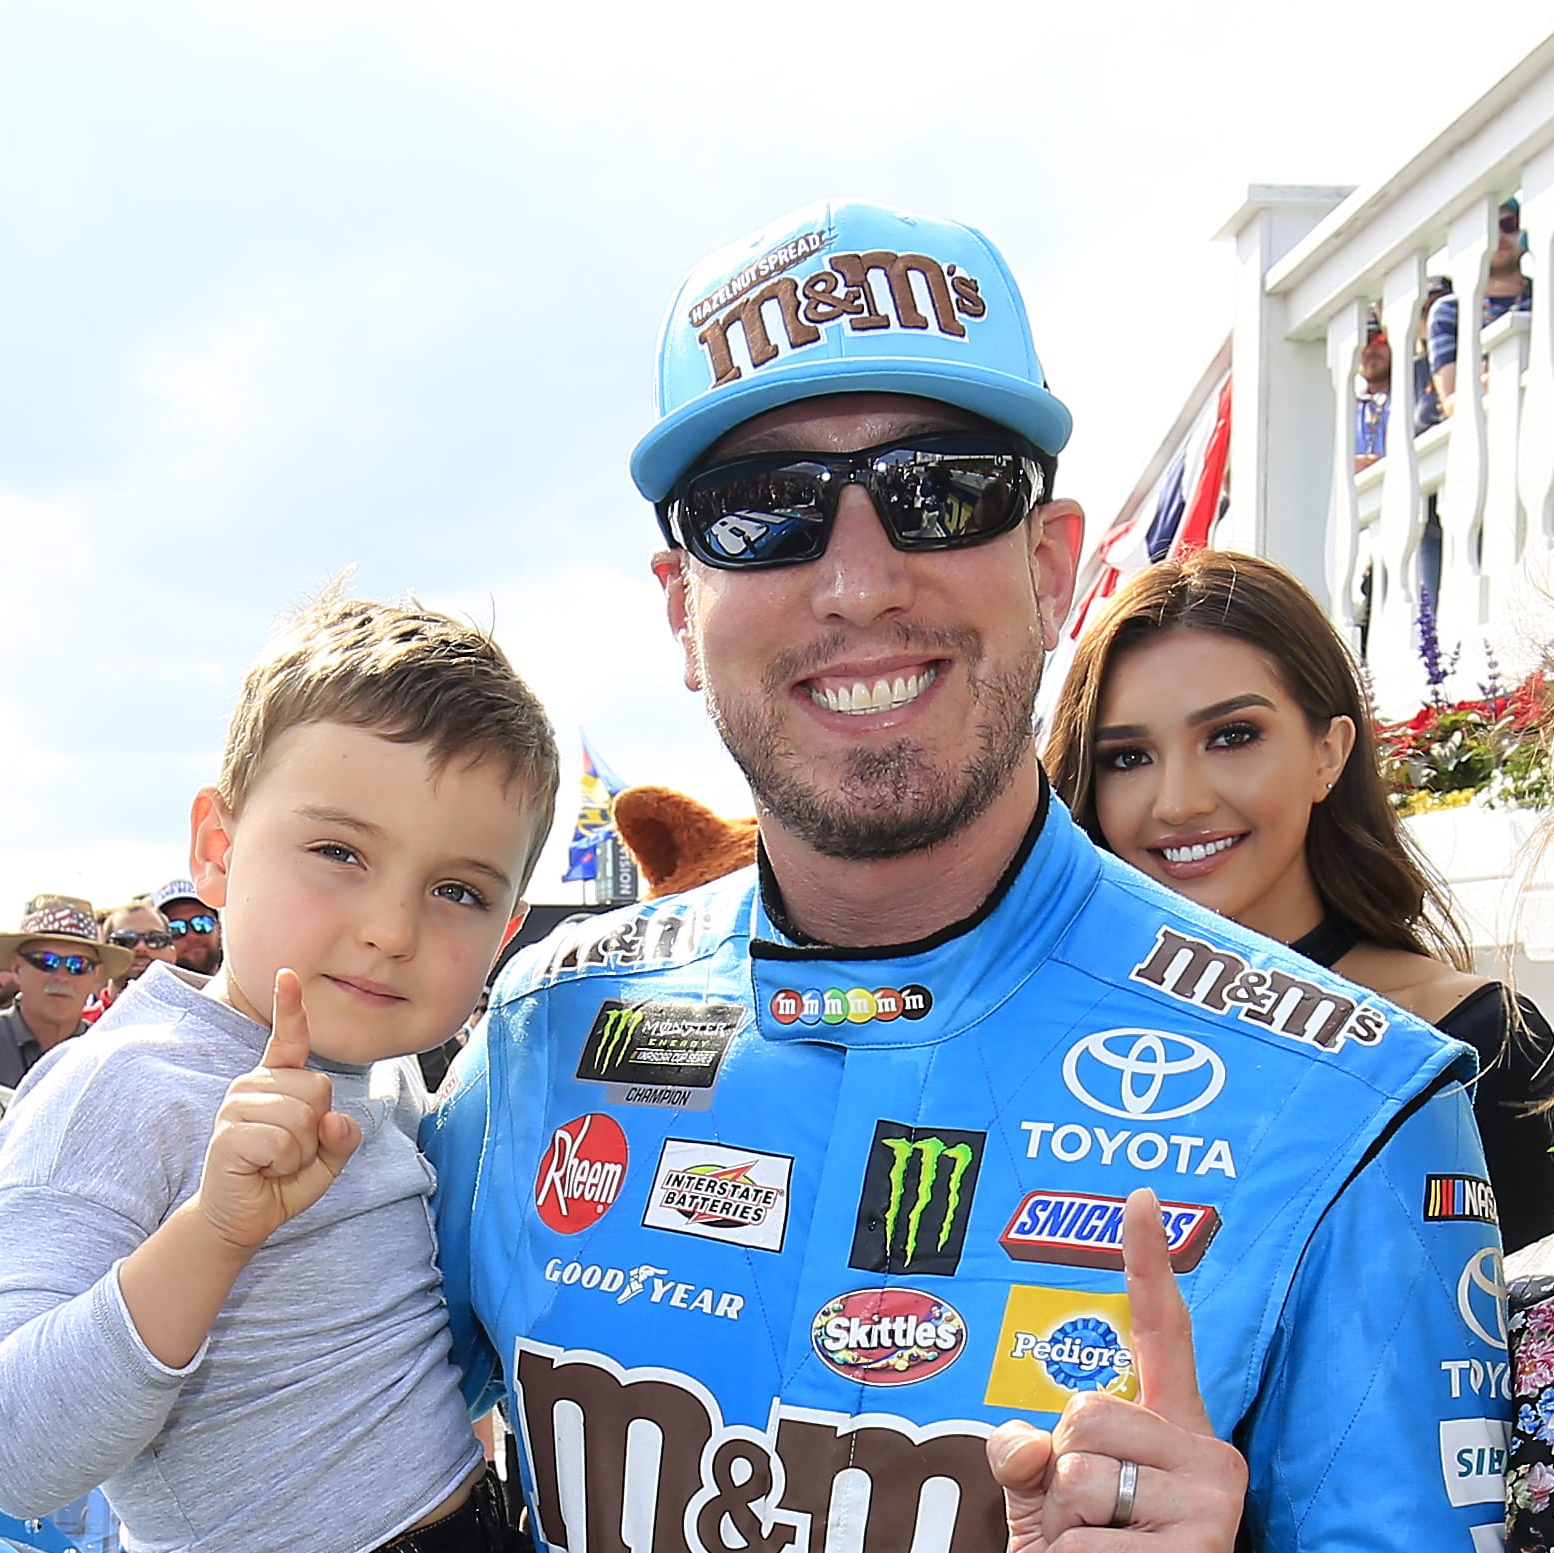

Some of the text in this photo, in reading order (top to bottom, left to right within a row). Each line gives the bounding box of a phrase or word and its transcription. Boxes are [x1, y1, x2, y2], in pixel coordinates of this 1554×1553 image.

[692, 233, 821, 324] HAZELNUT SPREAD
[625, 1087, 691, 1106] CHAMPION
[537, 1114, 623, 1216] Rheem
[1019, 1121, 1237, 1178] TOYOTA
[663, 1191, 765, 1222] BATTERIES
[665, 1172, 775, 1205] INTERSTATE
[824, 1315, 958, 1352] Skittles
[1010, 1332, 1132, 1370] Pedigre
